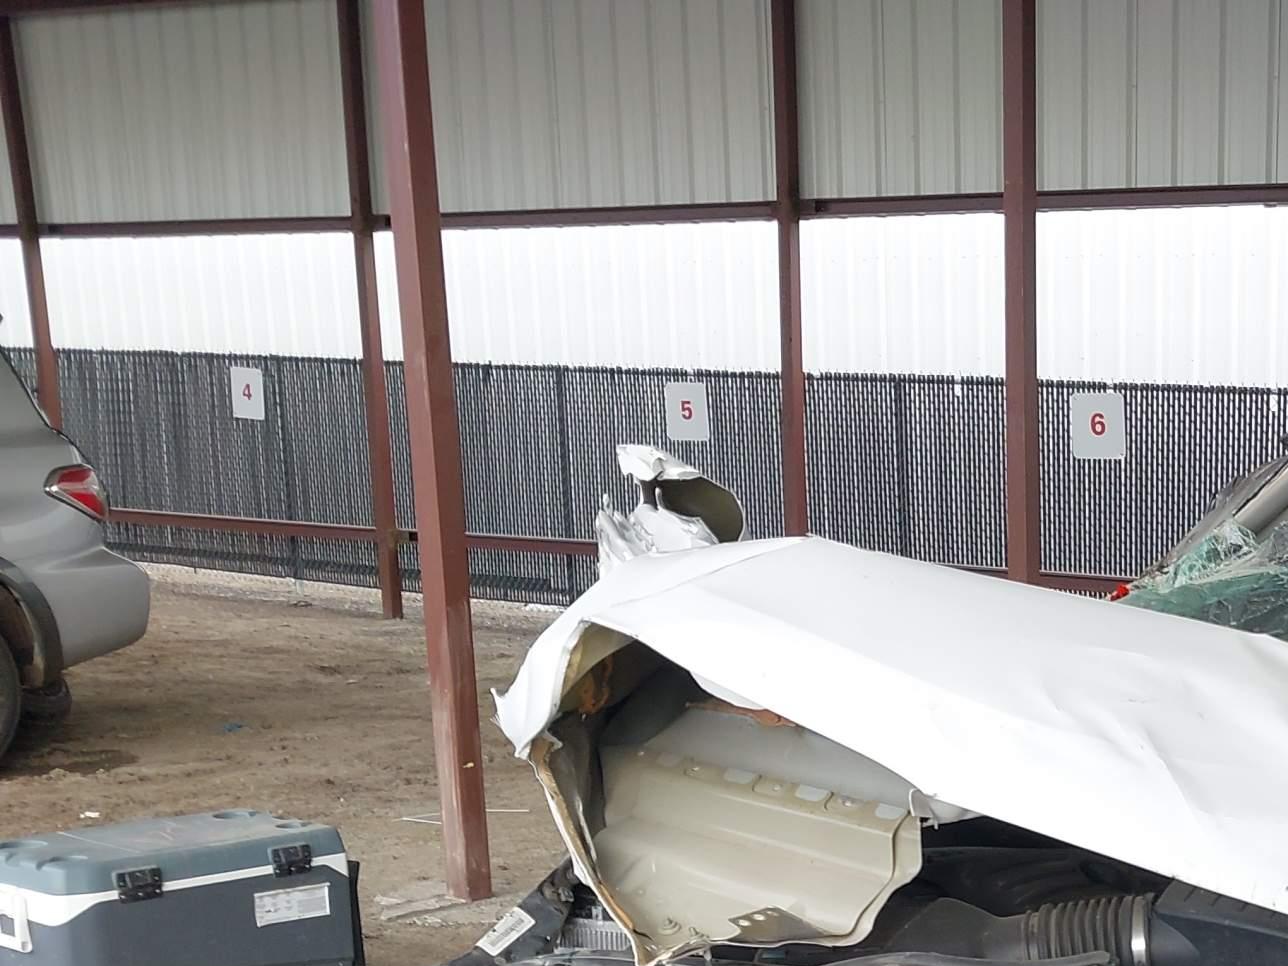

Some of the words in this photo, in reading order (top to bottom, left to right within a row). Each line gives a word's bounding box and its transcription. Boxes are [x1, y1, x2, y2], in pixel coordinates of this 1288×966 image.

[243, 383, 252, 400] 4
[681, 400, 693, 420] 5
[1089, 412, 1107, 437] 6
